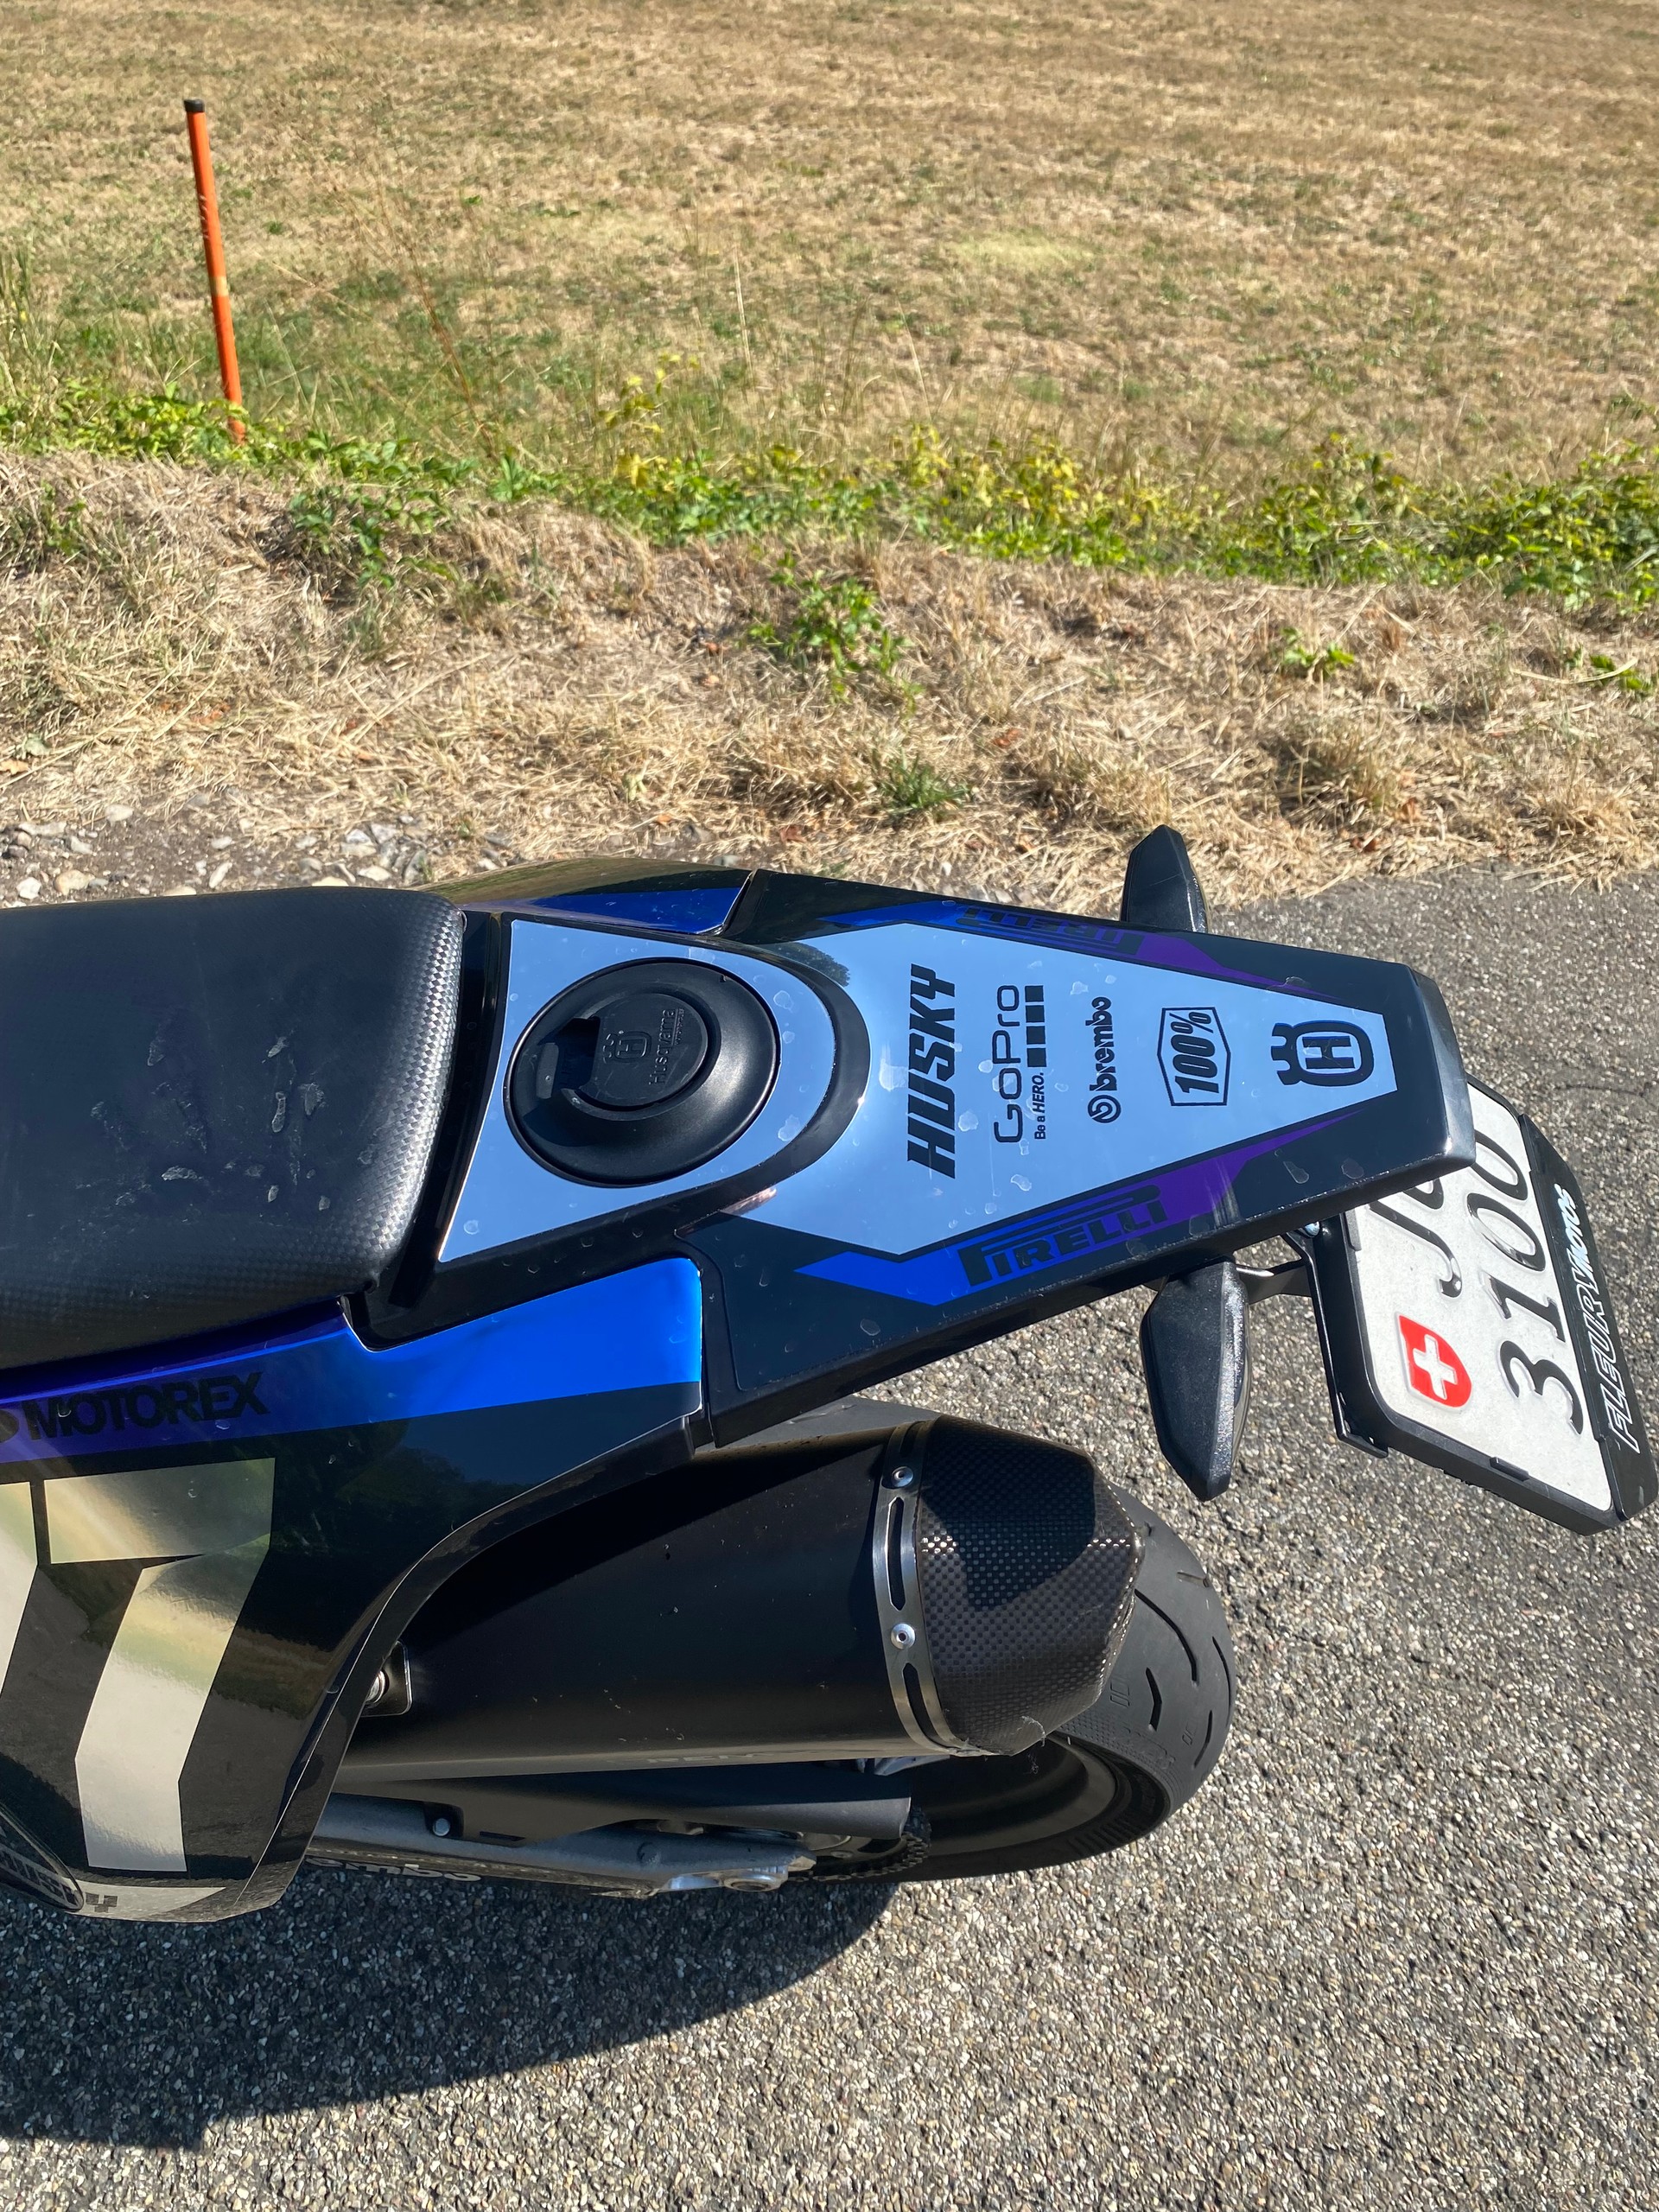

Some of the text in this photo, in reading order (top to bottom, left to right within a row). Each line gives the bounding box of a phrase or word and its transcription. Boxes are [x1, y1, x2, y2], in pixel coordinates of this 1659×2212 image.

[906, 963, 956, 1179] HUSKY
[992, 984, 1023, 1143] GoPro
[1085, 996, 1118, 1091] brembo
[1170, 1011, 1219, 1093] 100%
[1034, 1124, 1046, 1140] Be
[957, 1185, 1167, 1287] PIRELLI
[1466, 1132, 1584, 1435] 3100
[22, 1371, 270, 1441] MOTOREX
